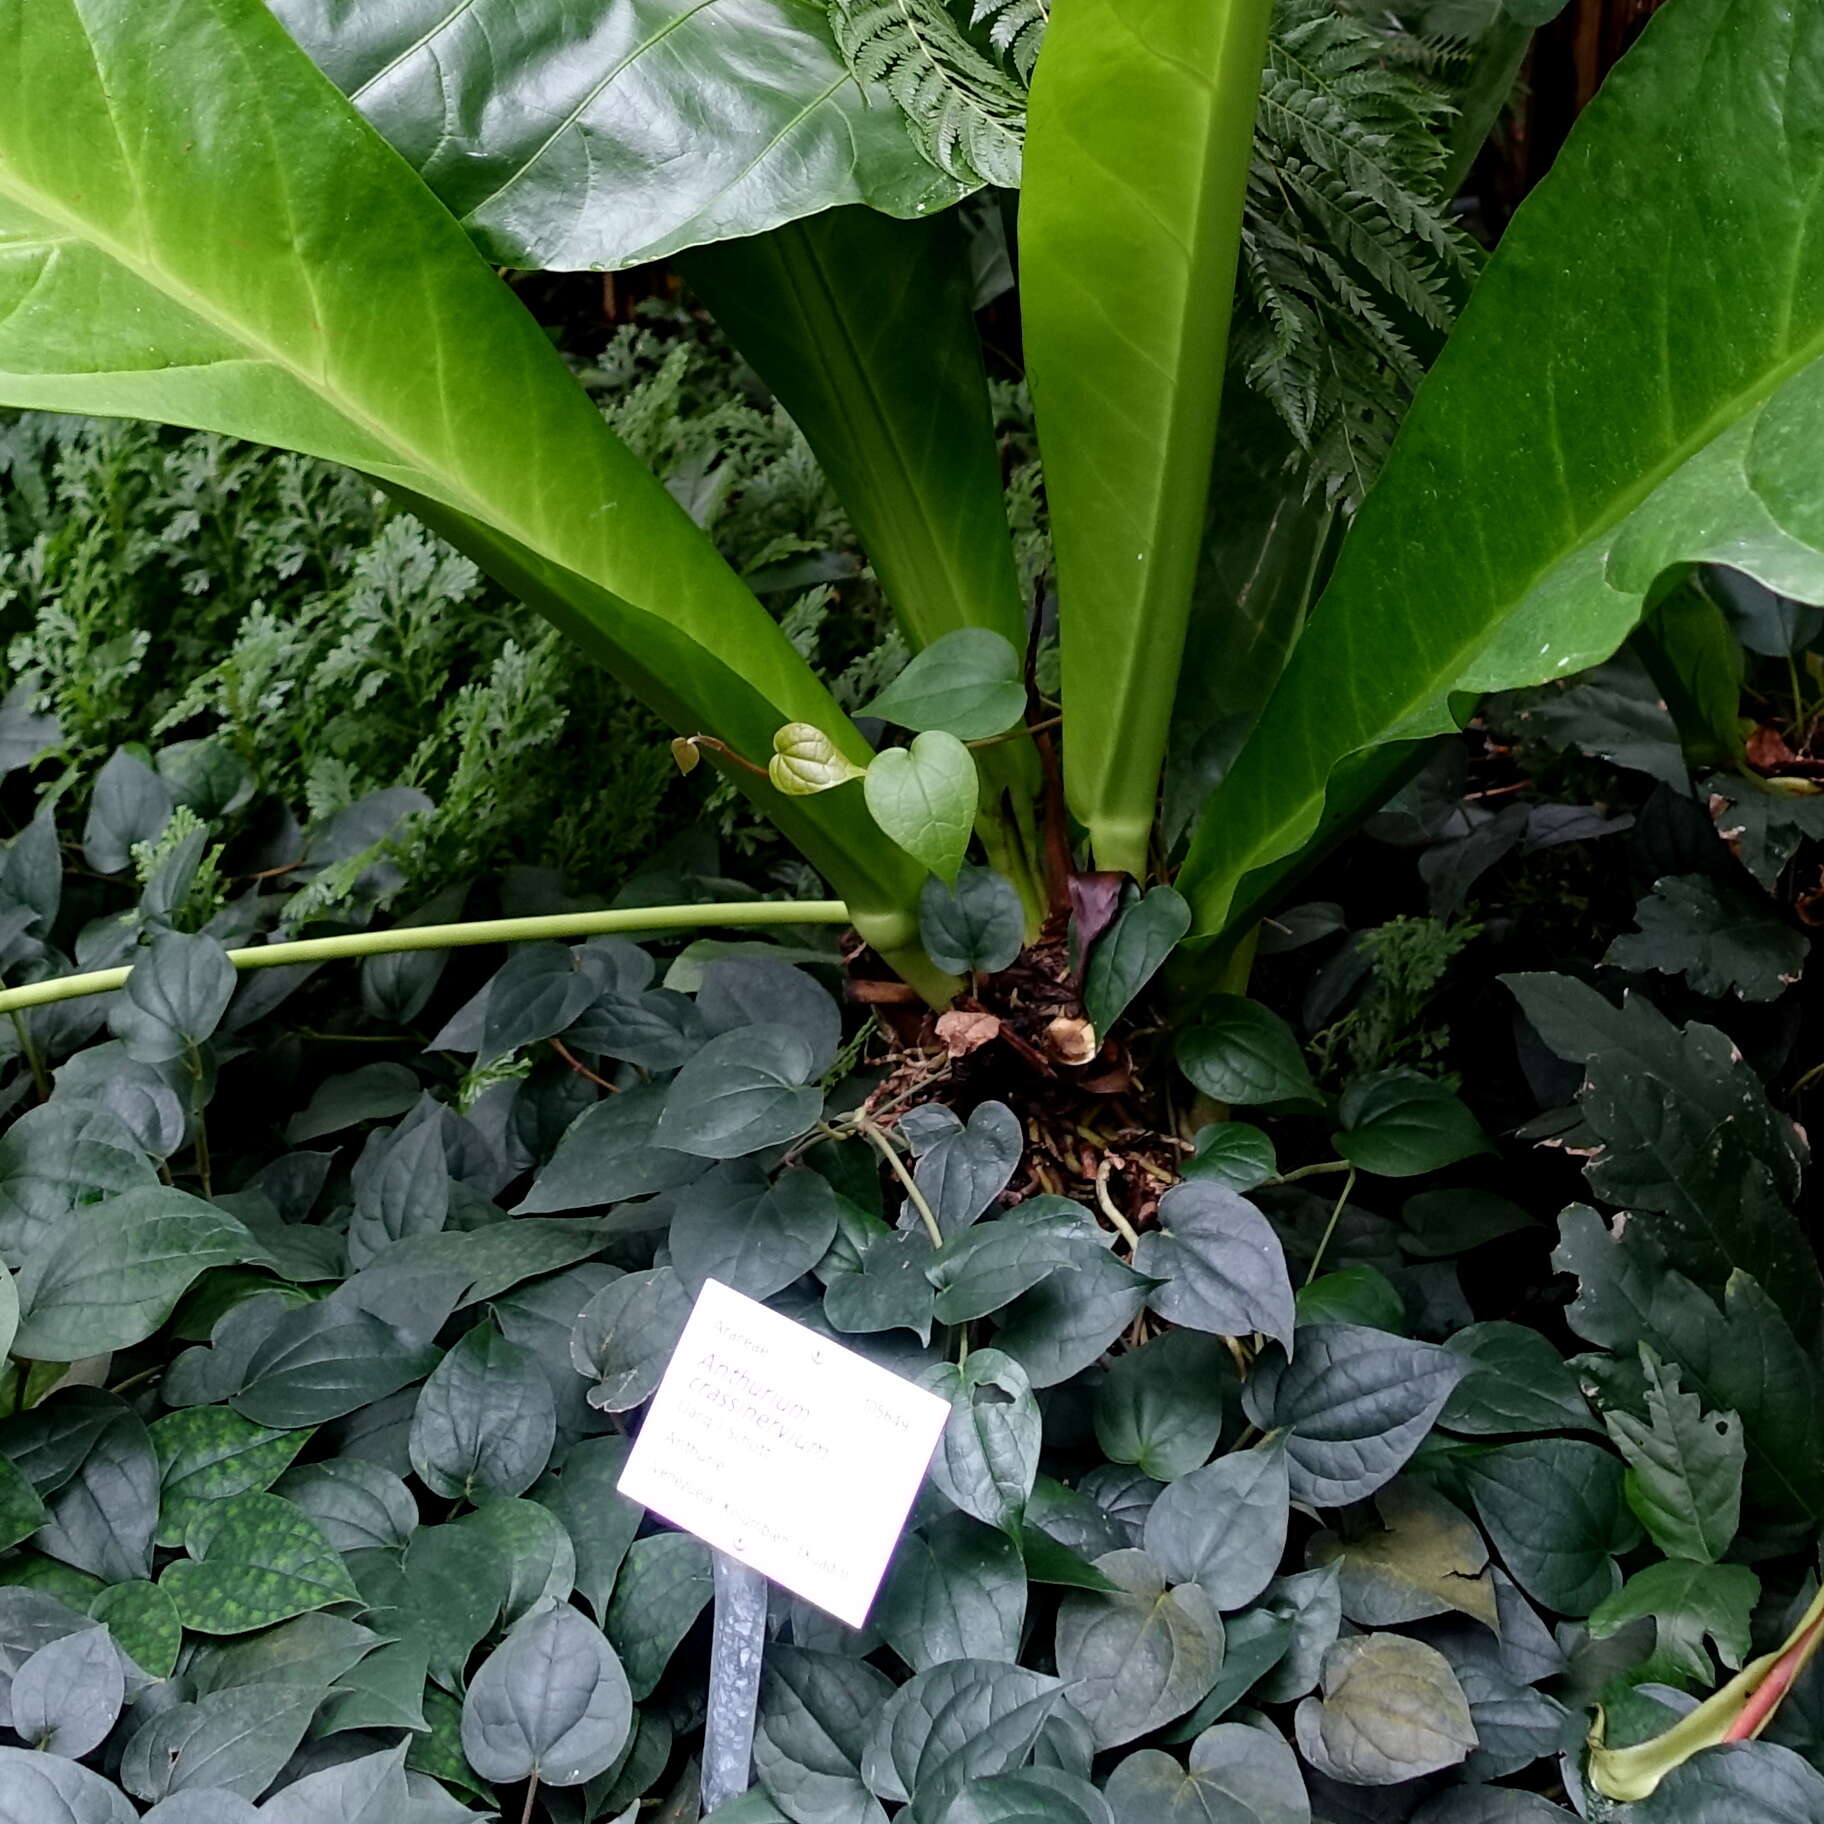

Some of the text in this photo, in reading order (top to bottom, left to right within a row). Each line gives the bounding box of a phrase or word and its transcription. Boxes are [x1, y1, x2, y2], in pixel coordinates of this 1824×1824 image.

[711, 1318, 769, 1358] Araceae
[687, 1375, 830, 1461] crassinervium
[695, 1351, 813, 1422] Anthurium
